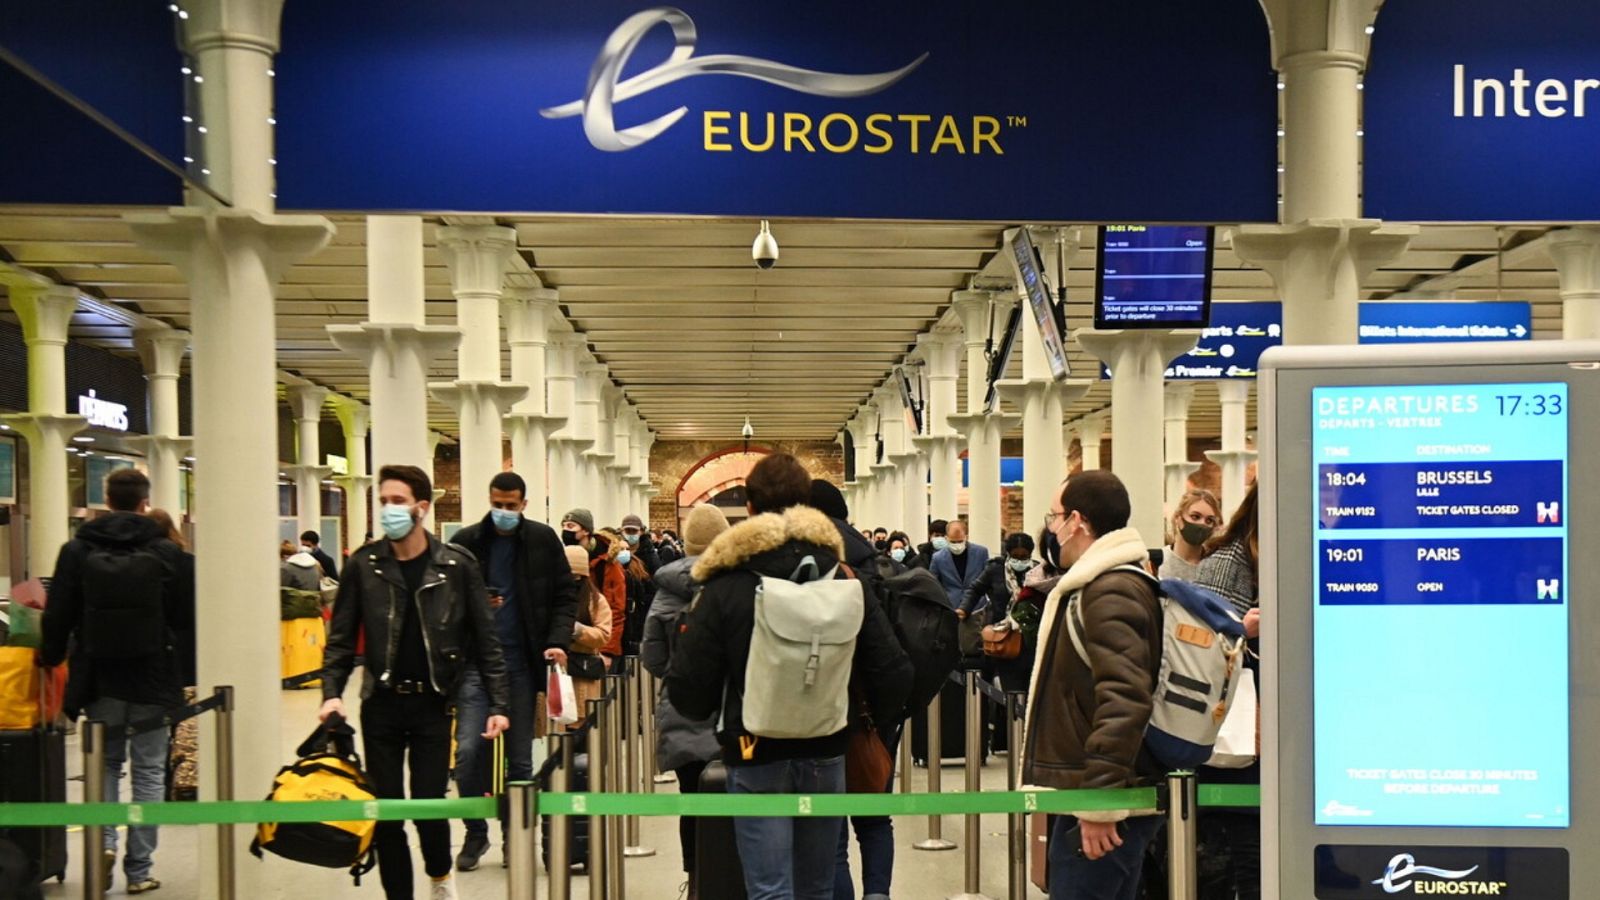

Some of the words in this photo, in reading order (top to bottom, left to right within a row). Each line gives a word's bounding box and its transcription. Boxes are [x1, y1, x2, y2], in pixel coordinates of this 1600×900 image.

[1454, 64, 1600, 117] Inter
[704, 111, 1004, 154] EUROSTAR
[1106, 225, 1126, 233] 19:01
[1128, 225, 1147, 233] Paris
[1128, 313, 1157, 321] departure
[1176, 365, 1224, 377] Premier
[1319, 395, 1479, 416] DEPARTURES
[1496, 394, 1563, 416] 17:33
[1324, 447, 1350, 457] TIME
[1416, 445, 1491, 456] DESTINATION
[1326, 472, 1366, 486] 18:04
[1416, 471, 1492, 485] BRUSSELS
[1416, 488, 1439, 497] LILLE
[1326, 506, 1354, 517] TRAIN
[1416, 506, 1449, 516] TICKET
[1450, 506, 1480, 515] GATES
[1482, 505, 1519, 515] CLOSED
[1327, 548, 1363, 562] 19:01
[1417, 548, 1460, 561] PARIS
[1327, 582, 1354, 592] TRAIN
[1417, 582, 1443, 592] OPEN
[1347, 768, 1388, 780] TICKET
[1390, 769, 1427, 780] GATES
[1429, 769, 1467, 780] CLOSE
[1486, 769, 1538, 780] MINUTES
[1384, 783, 1430, 795] BEFORE
[1432, 783, 1500, 795] DEPARTURE
[1414, 881, 1500, 895] EUROSTAR
